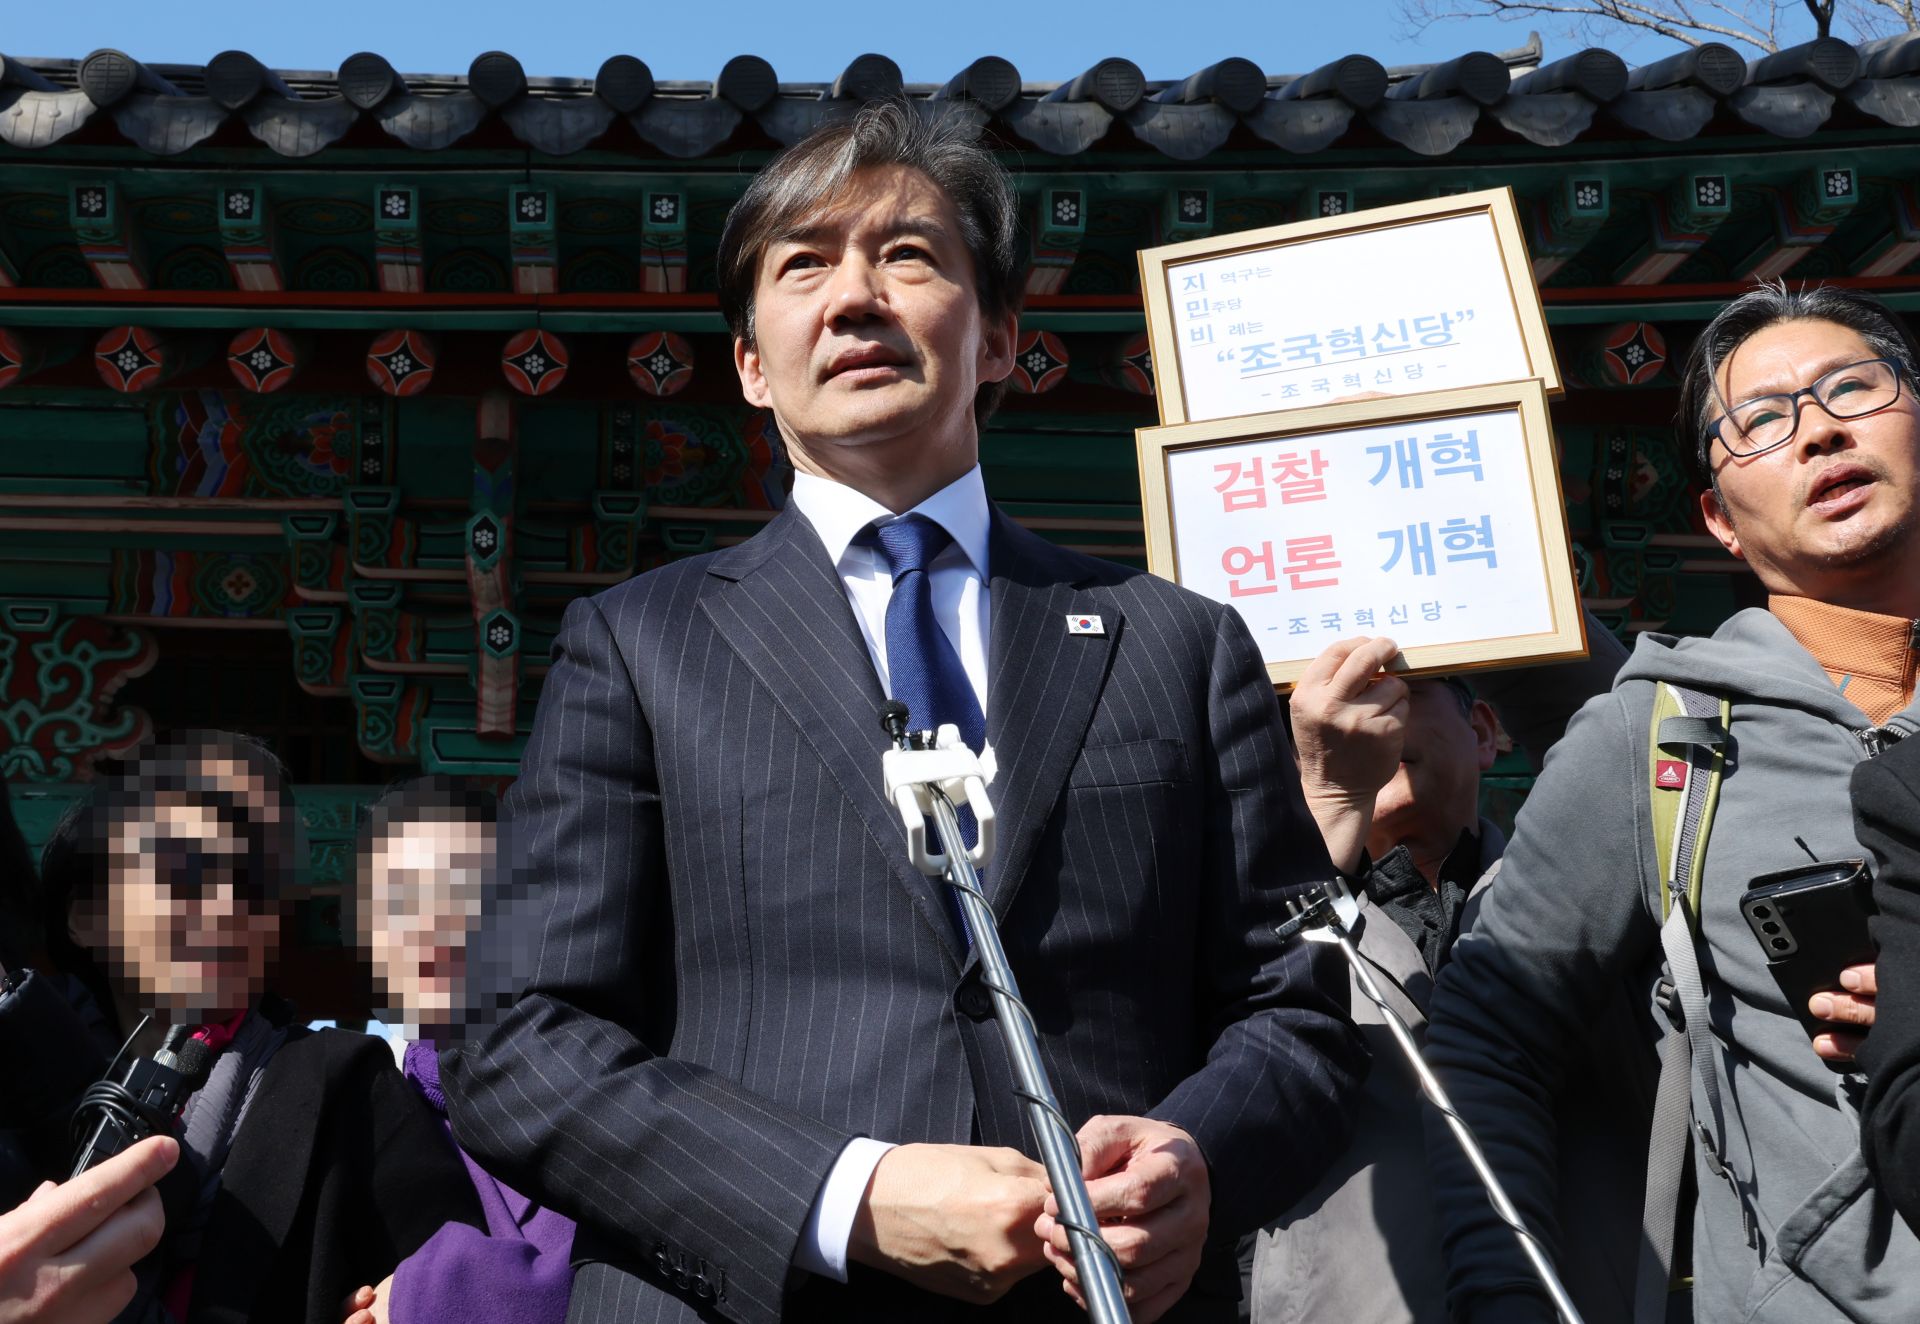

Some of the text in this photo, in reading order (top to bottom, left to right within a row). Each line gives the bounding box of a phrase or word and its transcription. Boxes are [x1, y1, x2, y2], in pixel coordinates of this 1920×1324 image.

[1183, 267, 1273, 291] 지 역구는
[1190, 323, 1214, 342] 비
[1213, 429, 1485, 513] 검찰 개혁
[1221, 514, 1498, 598] 언론 개혁
